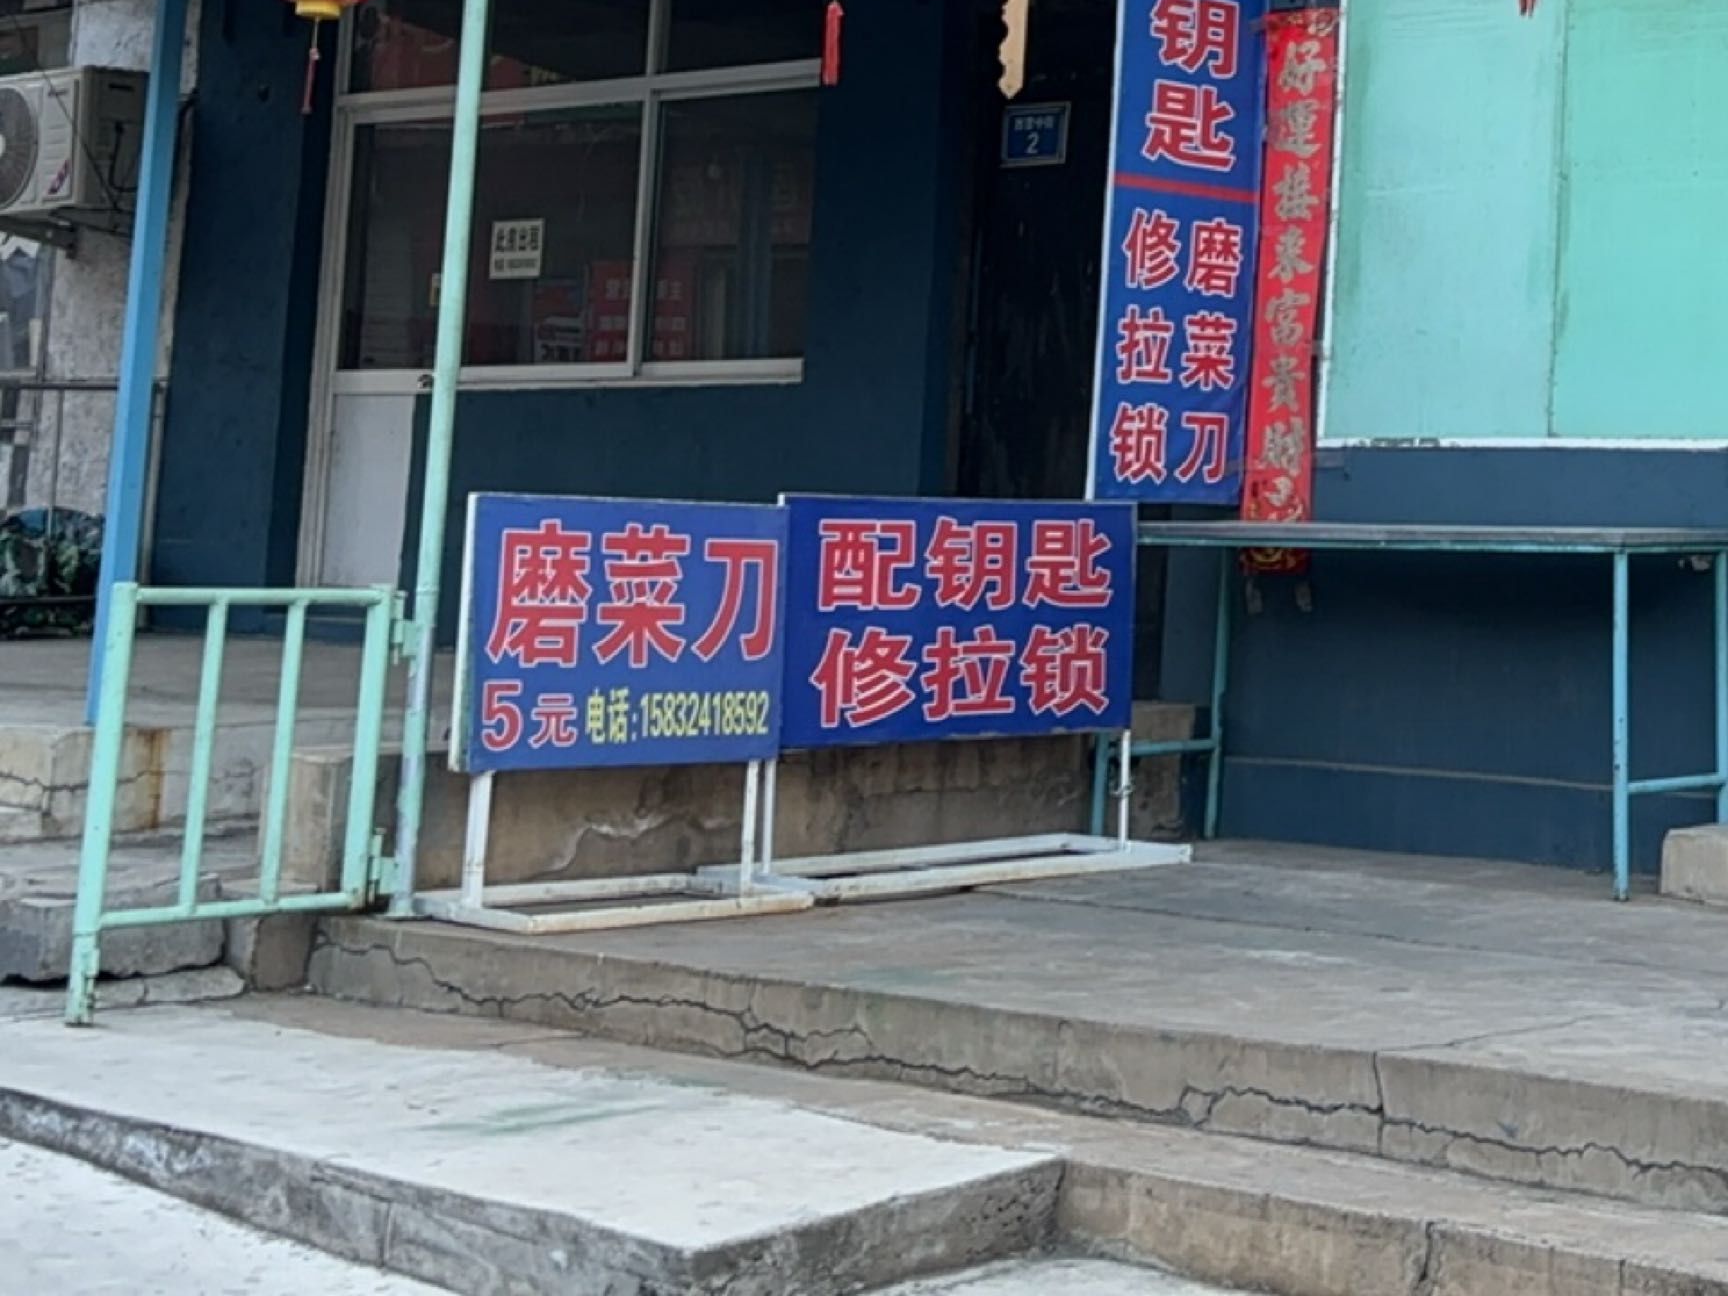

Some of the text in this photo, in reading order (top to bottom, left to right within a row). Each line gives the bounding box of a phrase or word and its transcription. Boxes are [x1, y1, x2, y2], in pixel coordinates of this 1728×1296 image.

[1108, 207, 1181, 486] 修拉锁
[1174, 217, 1243, 484] 磨菜刀
[485, 518, 779, 668] 磨菜刀
[819, 514, 1114, 610] 配钥匙
[481, 678, 579, 751] 5元
[809, 623, 1111, 728] 修拉锁
